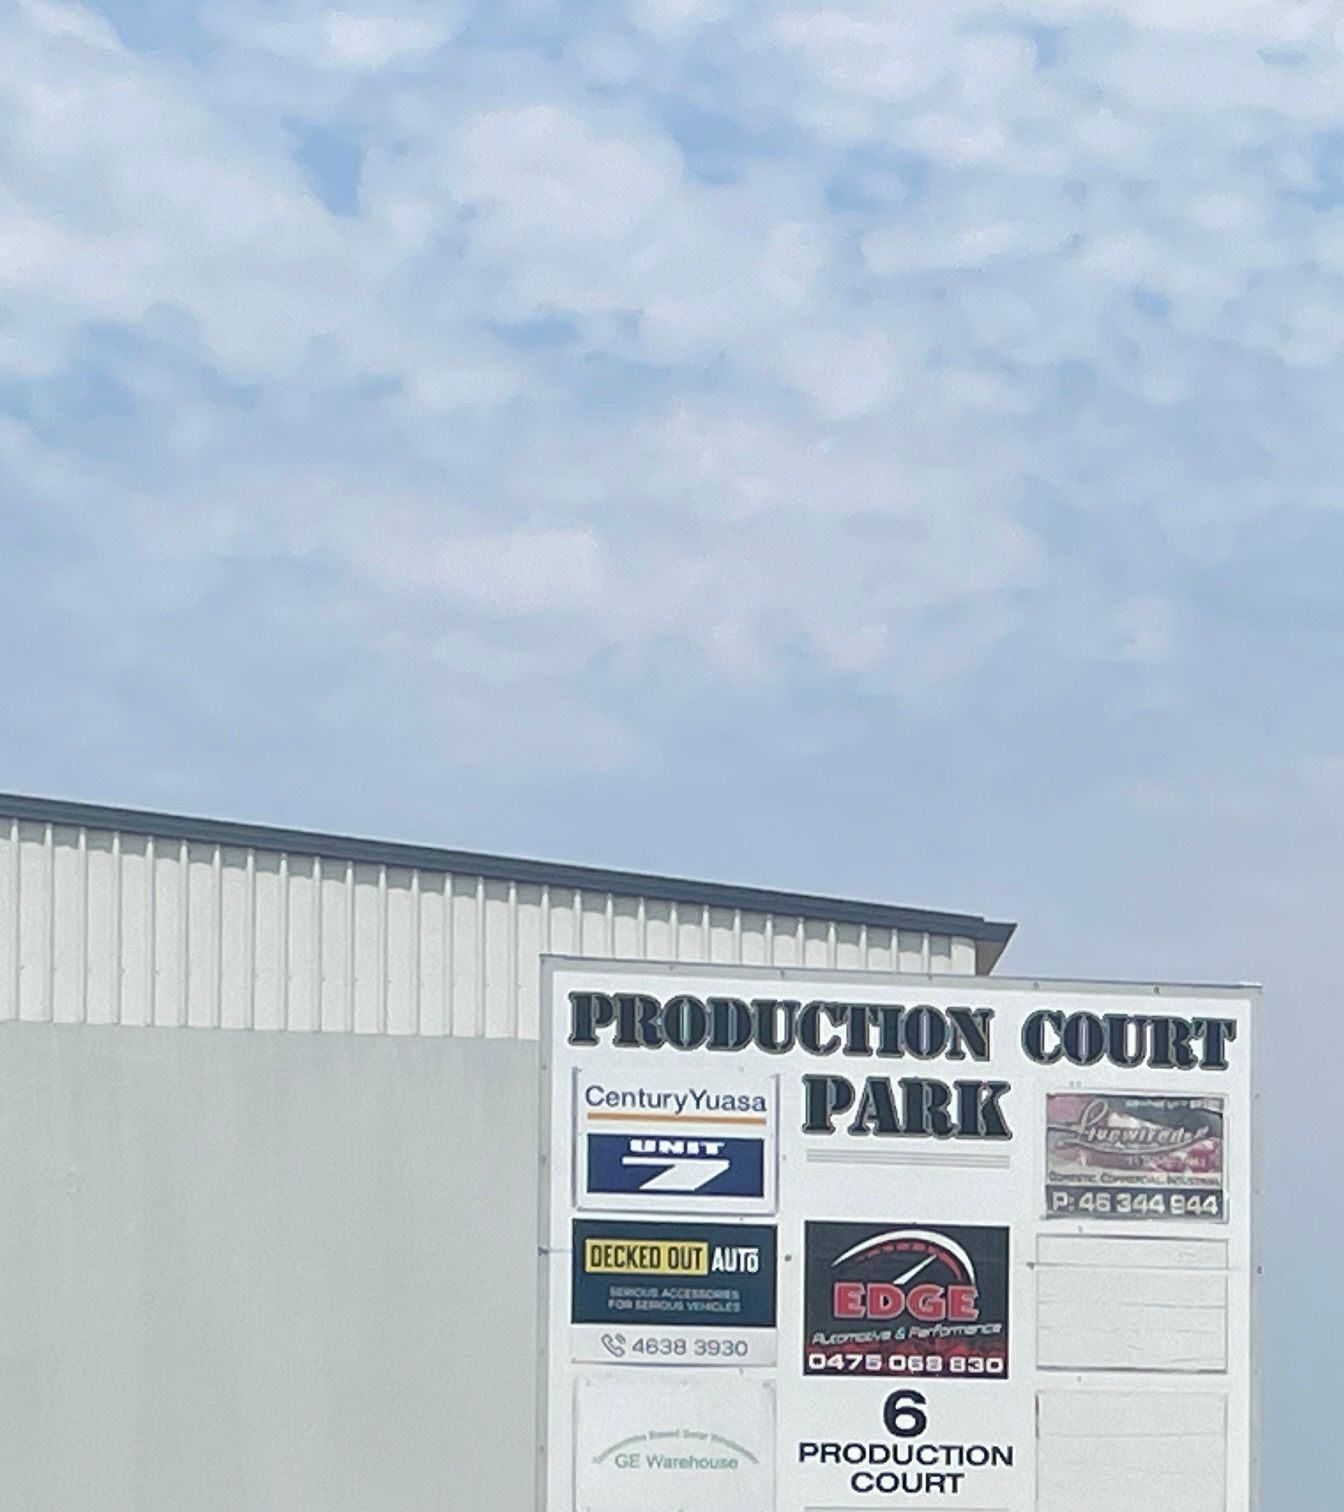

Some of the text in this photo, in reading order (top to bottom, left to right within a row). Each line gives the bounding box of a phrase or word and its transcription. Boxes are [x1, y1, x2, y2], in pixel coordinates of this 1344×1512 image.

[568, 991, 1237, 1071] PRODUCTION COURT
[585, 1085, 767, 1113] CenturyYuasa
[802, 1074, 1013, 1140] PARK
[629, 1139, 725, 1155] UNIT
[621, 1156, 730, 1191] 7
[1079, 1191, 1111, 1213] 46
[1116, 1192, 1165, 1214] 344
[590, 1244, 759, 1273] DECKED OUT AUTO
[609, 1287, 740, 1300] SERIOUS ACCESSORIES
[833, 1281, 979, 1322] EDGE
[608, 1299, 741, 1313] FOR SERIOUS VEHICLES
[812, 1323, 1002, 1345] Automotive & Performance
[632, 1337, 748, 1357] 4638 3930
[808, 1352, 882, 1370] 0475
[950, 1356, 1004, 1374] 830
[883, 1389, 928, 1438] 6
[614, 1453, 739, 1470] GE Warehouse
[798, 1442, 1014, 1467] PRODUCTION
[850, 1471, 966, 1494] COURT
